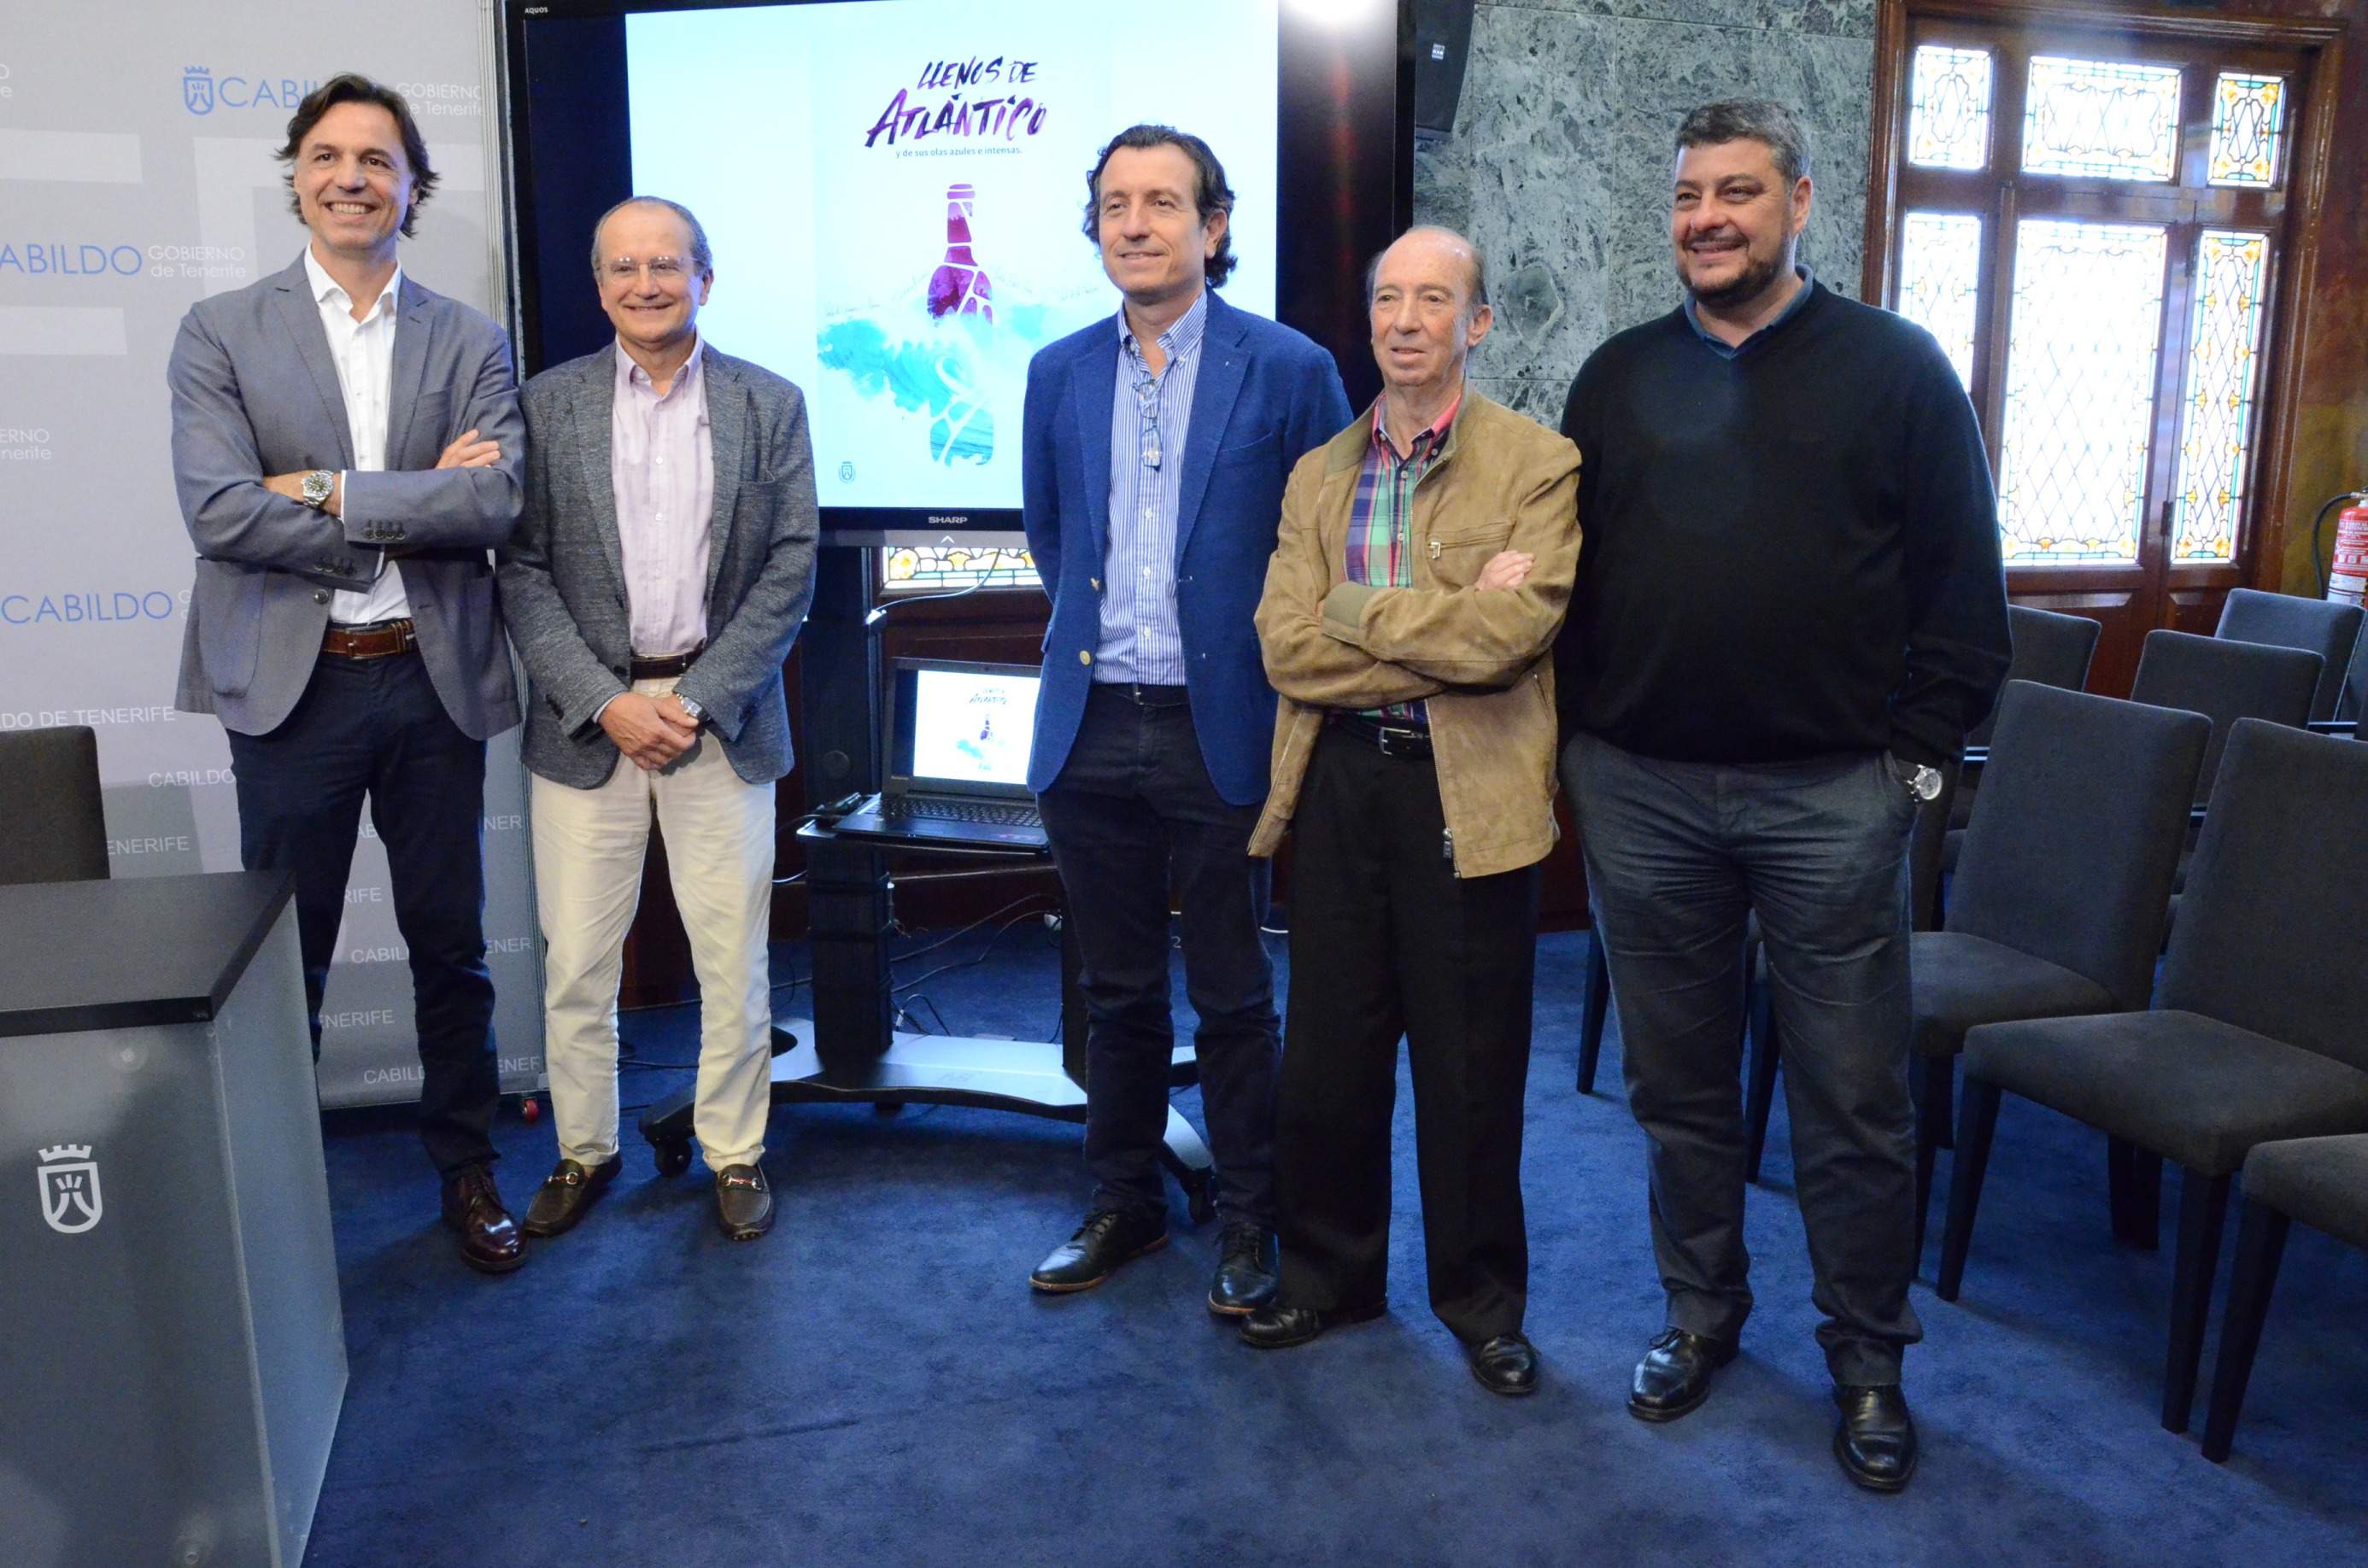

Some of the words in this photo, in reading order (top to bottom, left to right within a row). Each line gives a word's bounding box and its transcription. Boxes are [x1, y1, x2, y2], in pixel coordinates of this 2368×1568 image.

[218, 76, 319, 108] CABI
[895, 150, 900, 159] y
[902, 149, 913, 157] de
[930, 148, 947, 156] olas
[949, 147, 976, 155] azules
[0, 243, 143, 276] ABILDO
[148, 244, 245, 262] GOBIERNO
[150, 264, 174, 278] de
[178, 262, 246, 278] Tenerife
[0, 428, 50, 443] ERNO
[1, 445, 52, 460] nerife
[928, 516, 968, 524] SHARP
[1, 590, 173, 624] CABILDO
[39, 711, 69, 727] DE
[73, 705, 176, 726] TENERIFE
[148, 768, 237, 787] CABILDO
[107, 835, 190, 856] ENERIFE
[344, 887, 383, 904] RIFE
[350, 946, 410, 964] CABIL
[363, 1065, 425, 1084] CABILD
